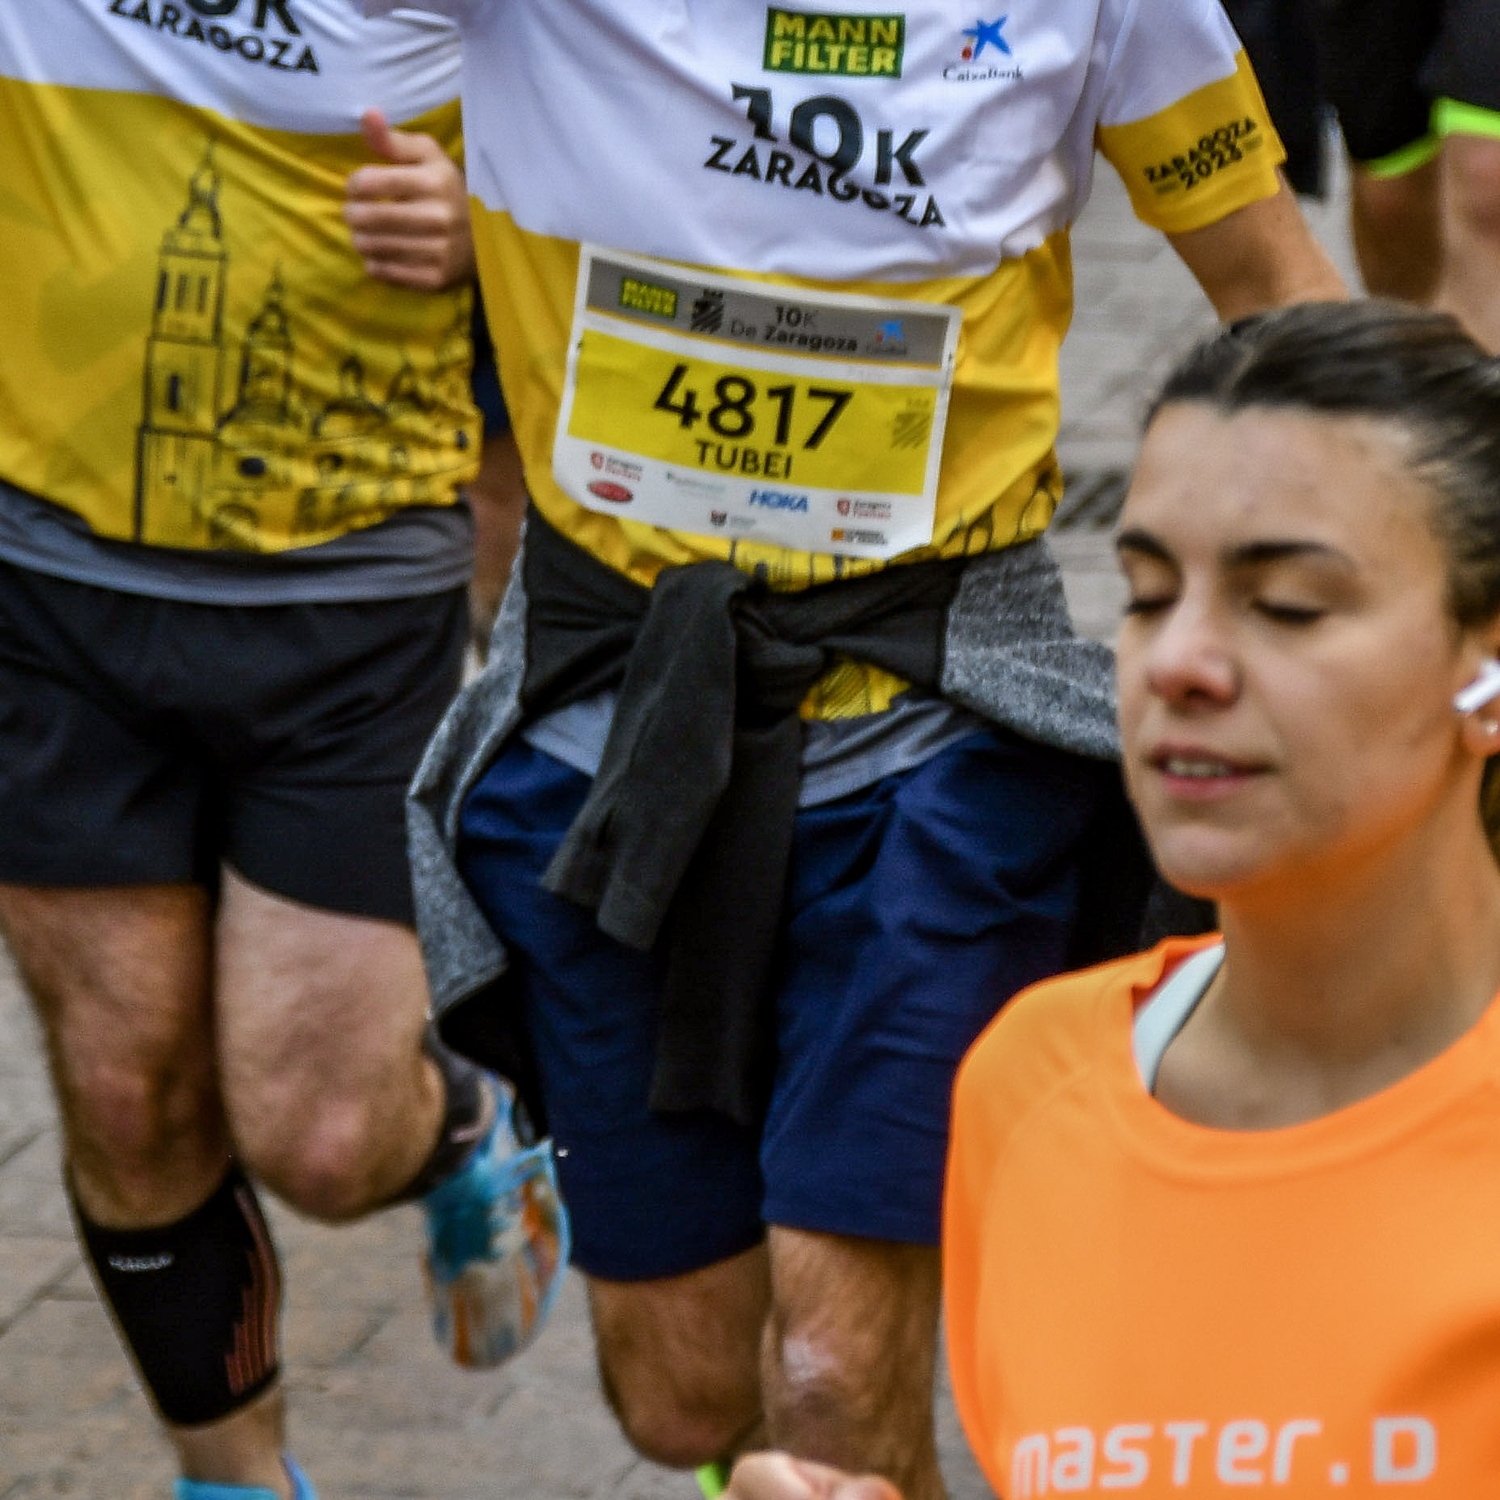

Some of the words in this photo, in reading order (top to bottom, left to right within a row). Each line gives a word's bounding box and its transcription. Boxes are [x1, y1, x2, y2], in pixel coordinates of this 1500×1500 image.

[772, 11, 898, 45] MANN
[769, 40, 897, 74] FILTER
[731, 84, 930, 188] 10K
[1143, 114, 1257, 184] ZARAGOZA
[704, 135, 946, 229] ZARAGOZA
[764, 325, 859, 352] Zaragoza
[653, 364, 854, 451] 4817
[695, 436, 793, 479] TUBEI
[750, 488, 809, 513] HOKA
[1010, 1415, 1439, 1500] master.D
